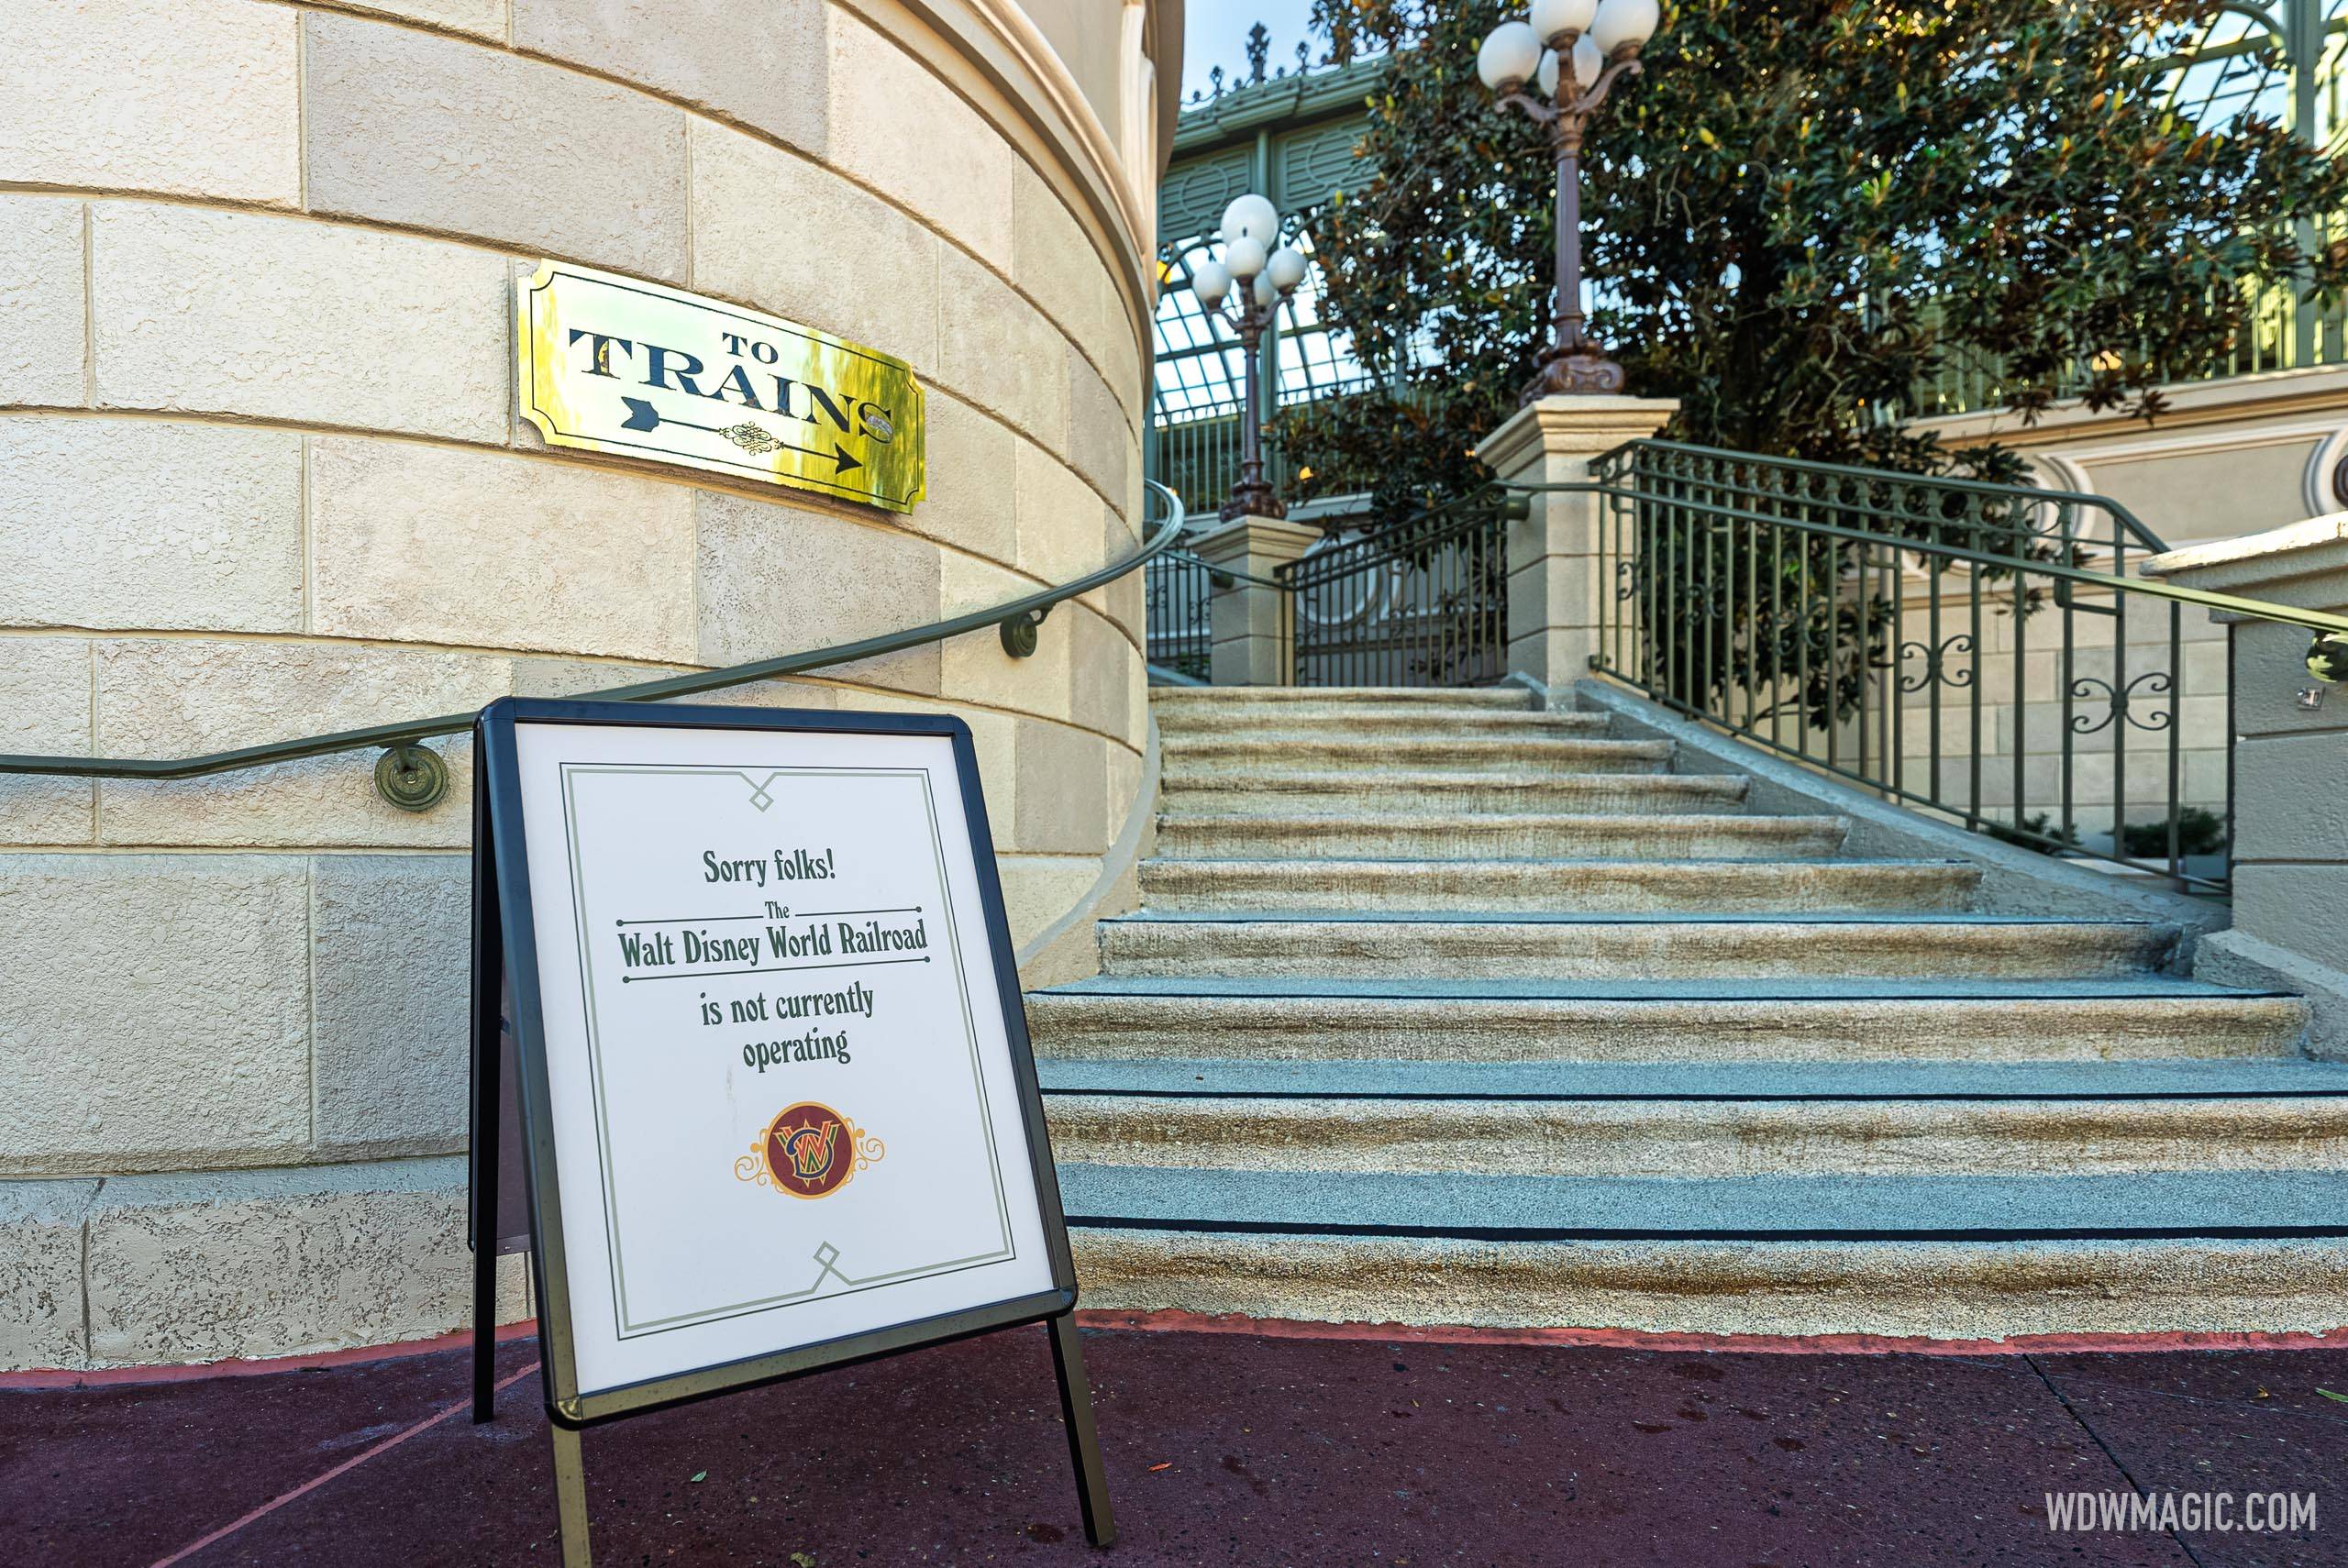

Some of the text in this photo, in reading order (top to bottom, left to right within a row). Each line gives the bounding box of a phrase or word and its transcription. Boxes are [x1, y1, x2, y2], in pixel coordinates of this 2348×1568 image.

[722, 331, 779, 365] TO
[569, 327, 894, 445] TRAINS
[703, 848, 835, 887] Sorry folks!
[765, 901, 790, 919] The
[617, 919, 927, 966] Walt Disney World Railroad
[700, 981, 873, 1025] is not currently
[743, 1027, 850, 1073] operating
